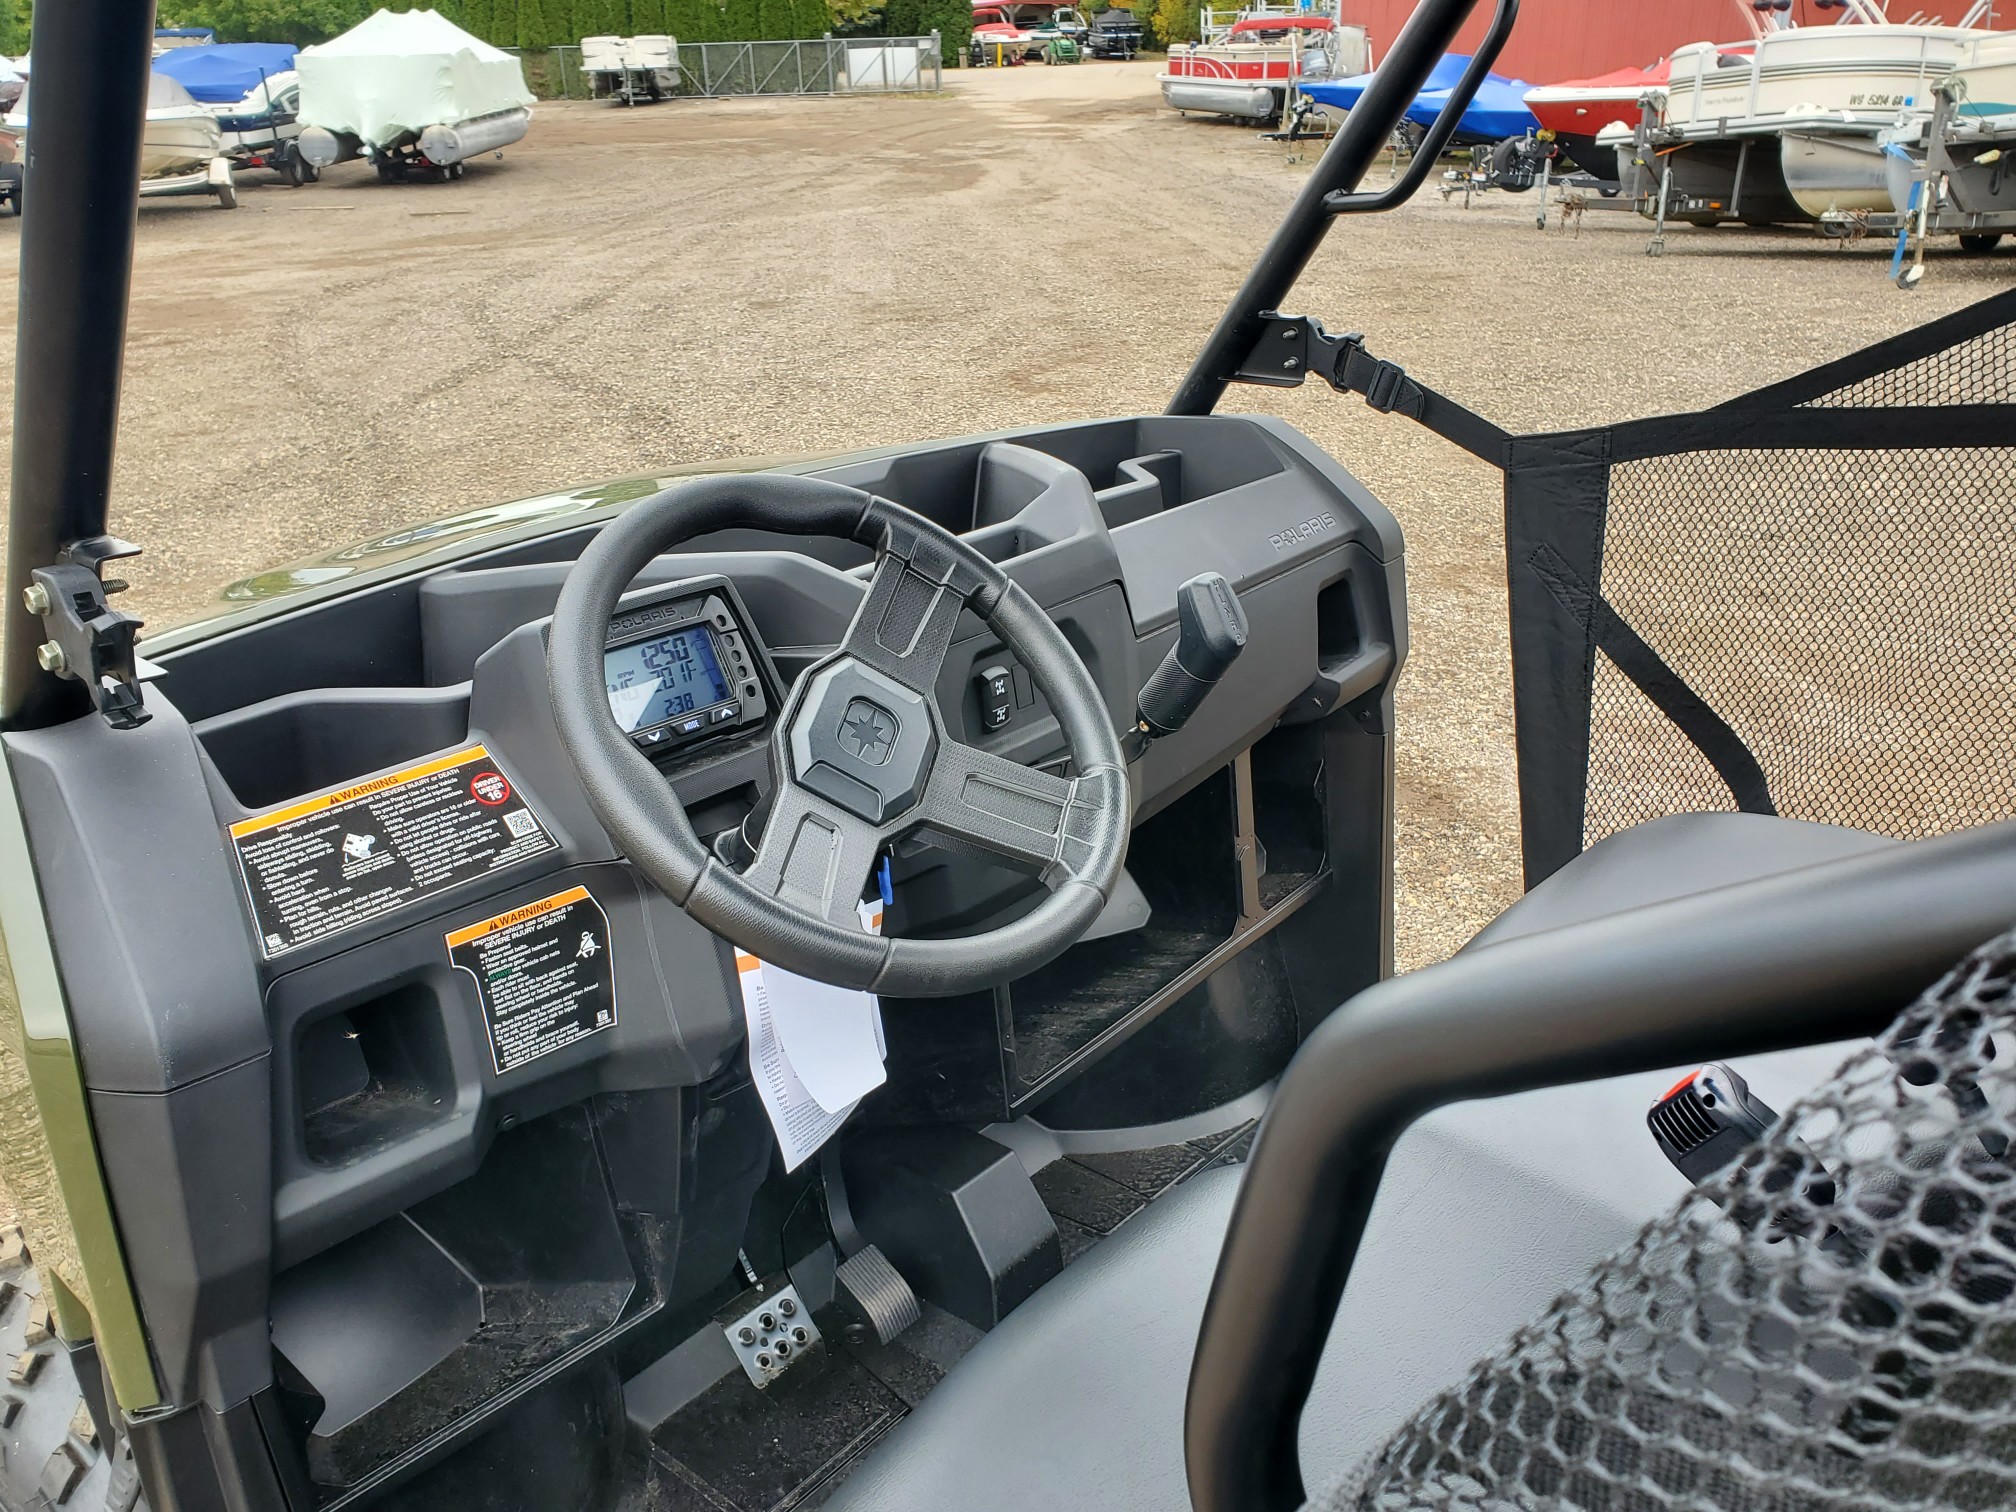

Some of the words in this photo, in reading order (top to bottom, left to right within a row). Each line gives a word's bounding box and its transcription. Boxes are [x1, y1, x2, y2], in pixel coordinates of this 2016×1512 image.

[1268, 512, 1336, 552] POLARIS
[609, 607, 676, 633] POLARIS
[684, 720, 700, 730] MODE
[342, 776, 398, 799] WARNING
[473, 776, 500, 789] DRIVER
[478, 782, 503, 794] UNDER
[277, 819, 306, 832] Improper
[308, 812, 330, 821] vehicle
[356, 797, 374, 806] result
[381, 786, 406, 797] SEVERE
[407, 778, 429, 789] INJURY
[438, 769, 459, 779] DEATH
[488, 790, 502, 800] 16
[500, 901, 552, 925] WARNING
[472, 933, 500, 947] Improper
[502, 924, 524, 935] vehicle
[550, 907, 566, 918] result
[485, 935, 510, 949] SEVERE
[512, 926, 534, 939] INJURY
[544, 914, 566, 927] DEATH
